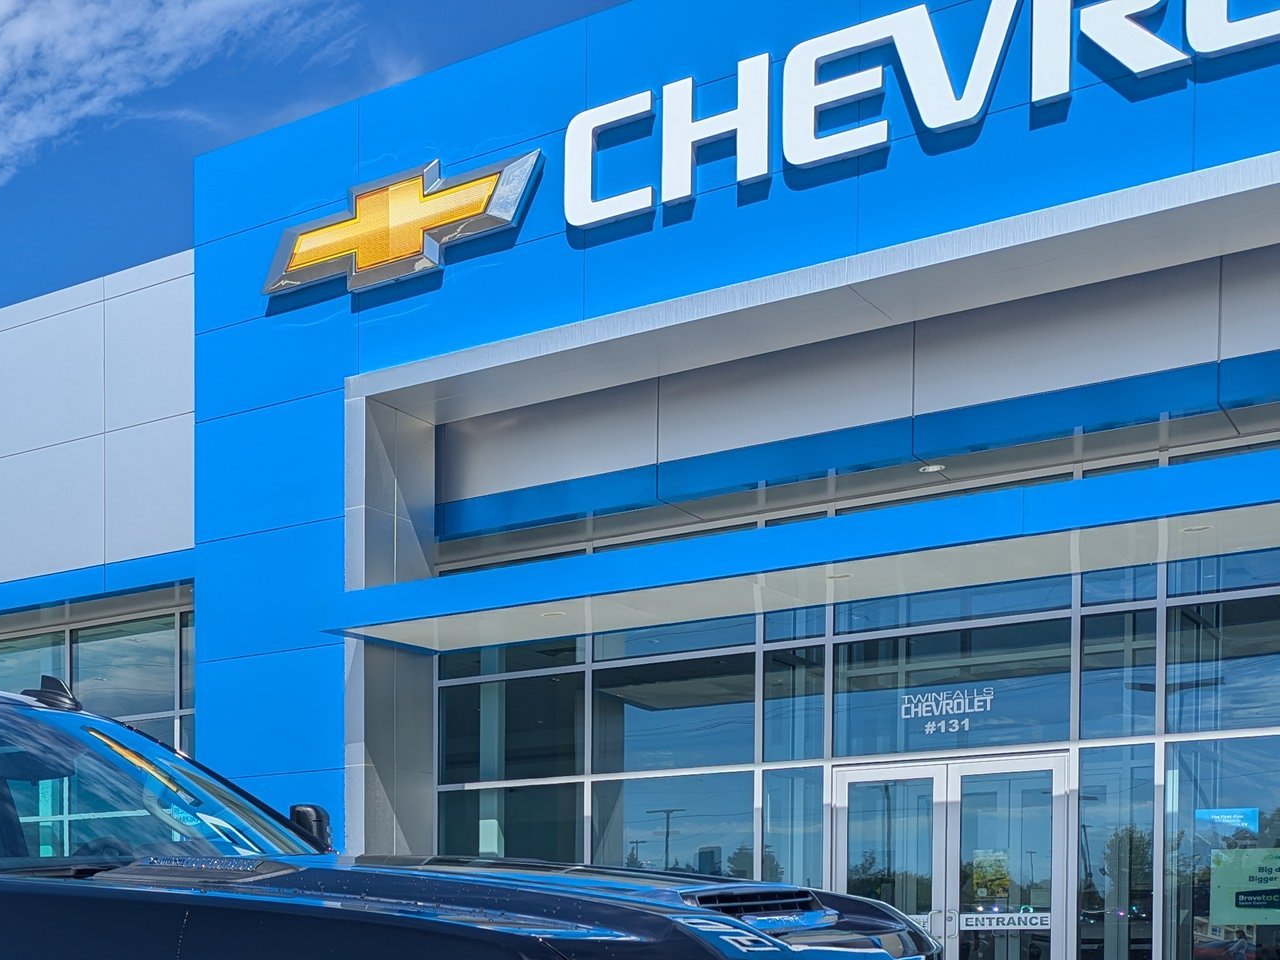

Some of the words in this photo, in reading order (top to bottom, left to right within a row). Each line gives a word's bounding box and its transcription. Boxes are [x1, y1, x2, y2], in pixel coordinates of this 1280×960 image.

[900, 696, 994, 719] CHEVROLET
[924, 717, 970, 735] #131
[1258, 866, 1273, 874] Big
[1248, 875, 1278, 884] Bigger
[964, 915, 1050, 928] ENTRANCE
